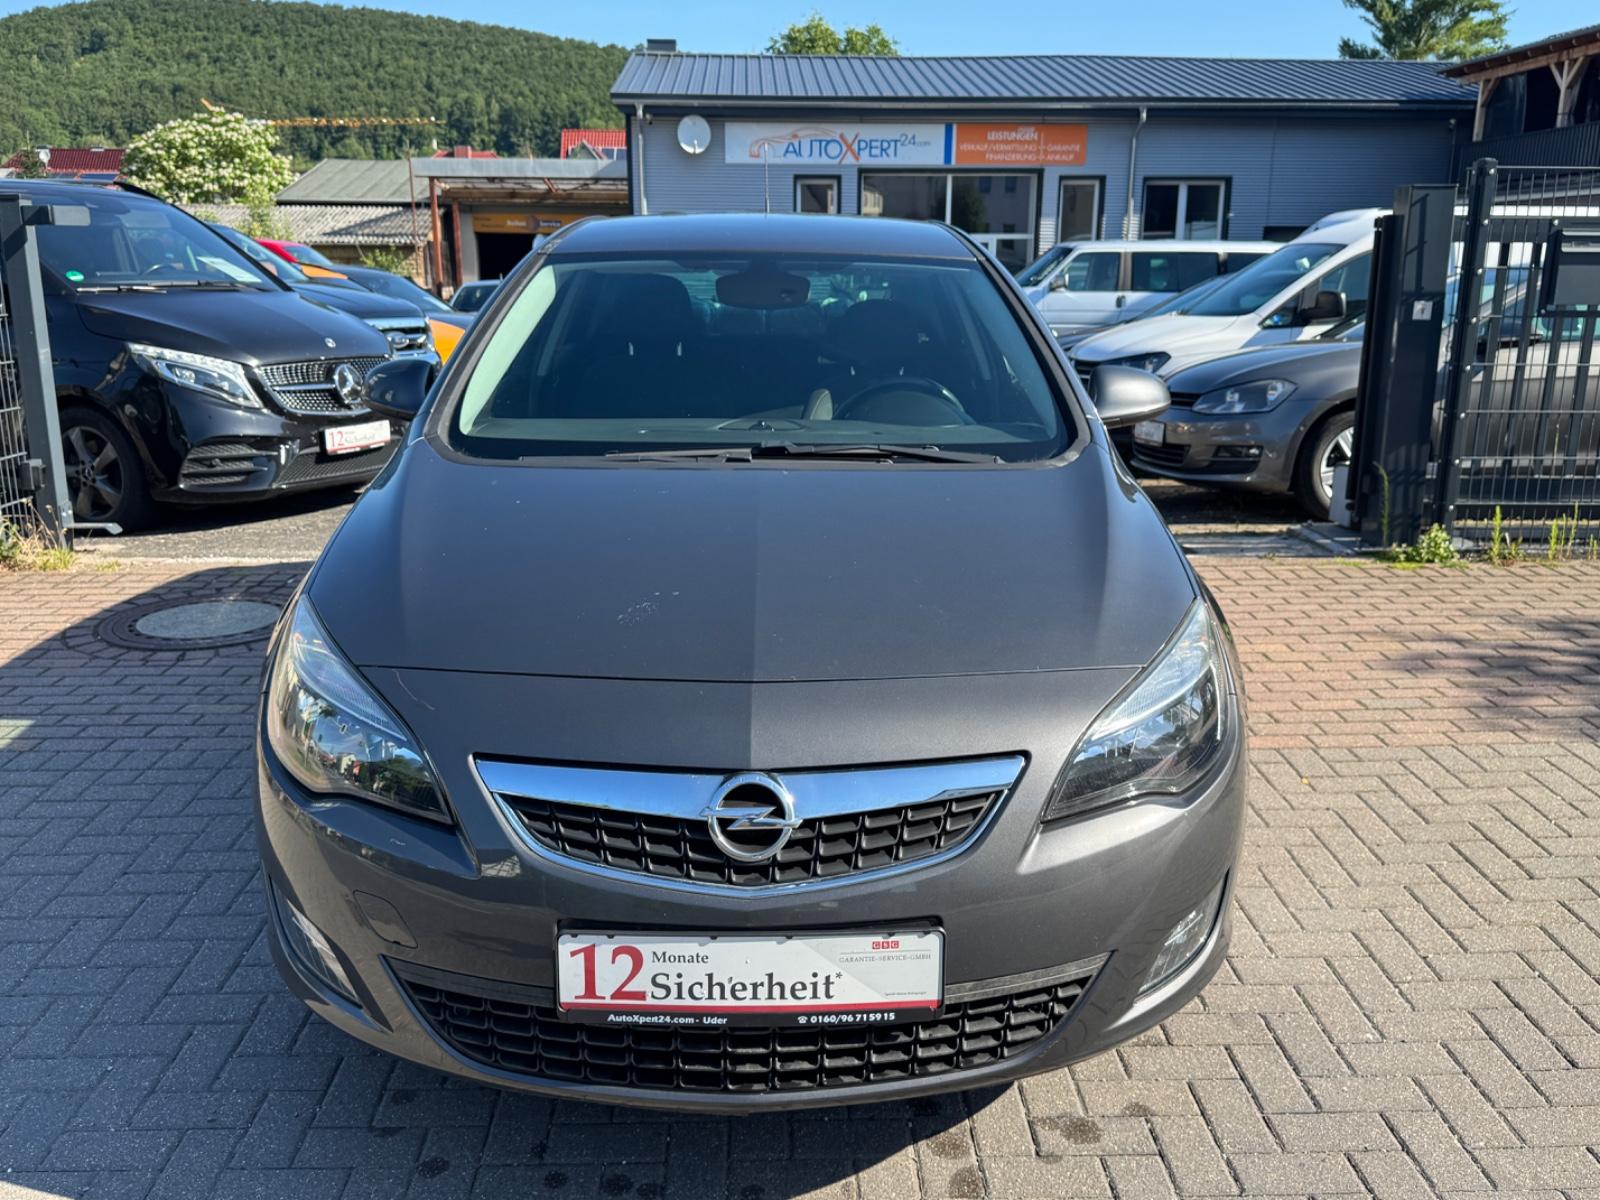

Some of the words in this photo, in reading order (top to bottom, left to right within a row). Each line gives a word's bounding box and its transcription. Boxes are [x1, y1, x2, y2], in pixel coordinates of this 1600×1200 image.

[987, 131, 1039, 141] LEISTUNGEN
[329, 430, 344, 448] 12
[651, 951, 709, 964] Monate
[569, 943, 647, 1001] 12
[703, 1016, 727, 1025] Uder
